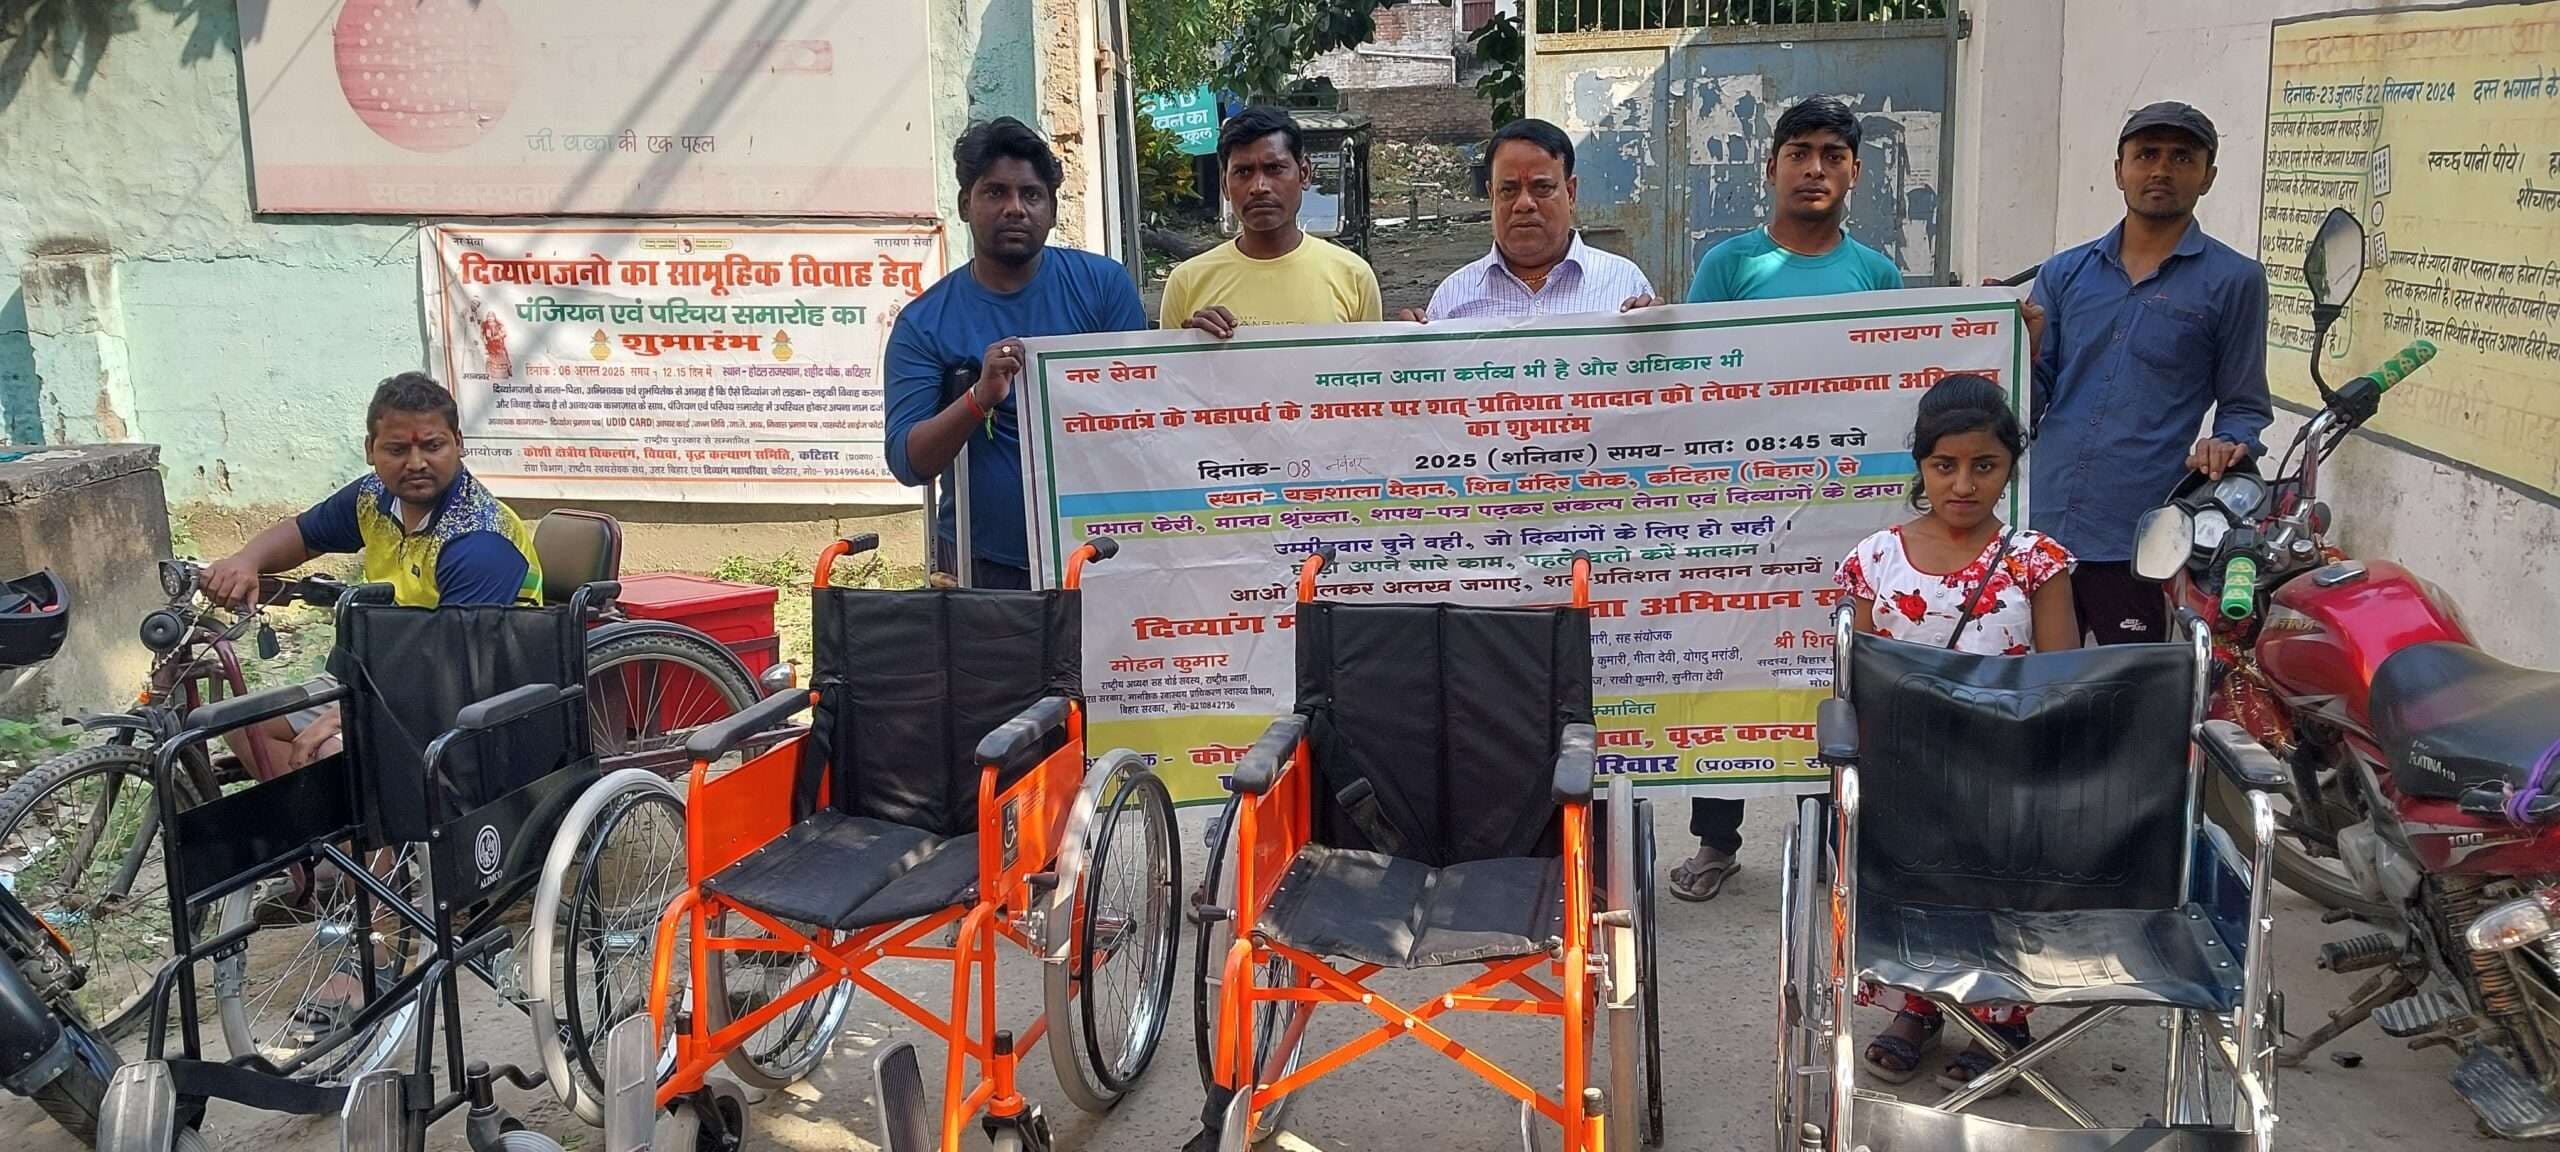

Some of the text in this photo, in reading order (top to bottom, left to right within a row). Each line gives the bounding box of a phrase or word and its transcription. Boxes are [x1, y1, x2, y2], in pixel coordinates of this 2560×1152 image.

[2383, 76, 2424, 104] सितम्बर
[2426, 82, 2456, 101] 2024
[2474, 64, 2560, 103] दस्त भगाने के
[1186, 110, 1209, 125] का
[618, 128, 637, 153] की
[647, 135, 672, 153] एक
[680, 135, 715, 154] पहल
[2428, 151, 2462, 175] स्वच्छ
[2463, 143, 2493, 173] पानी
[873, 235, 933, 248] नारायण सेवा
[459, 252, 924, 297] दिव्यांगजनो का सामूहिक विवाह हेतु
[2470, 256, 2544, 286] पतला होता
[2385, 278, 2405, 298] दस्त
[515, 296, 867, 326] पंजियन एवं परिचय समारोह का
[2454, 289, 2547, 321] दस्त पानी
[617, 330, 763, 356] शुभारंभ
[1848, 317, 1999, 343] नारायण सेवा
[2498, 329, 2547, 361] आशा दीदी
[559, 365, 570, 377] 06
[574, 365, 600, 377] अगस्त
[602, 365, 625, 377] 2025
[1065, 361, 1157, 383] नर सेवा
[1315, 371, 1383, 388] मतदान
[1390, 368, 1446, 384] अपना
[1523, 358, 1547, 378] भी
[1554, 358, 1570, 380] है
[1578, 357, 1618, 376] और
[1626, 353, 1712, 374] अधिकार
[1720, 349, 1744, 368] भी
[1062, 408, 1156, 433] लोकतंत्र
[1160, 407, 1187, 427] के
[1191, 402, 1272, 425] महापर्व
[1276, 400, 1303, 420] के
[1311, 401, 1384, 419] अवसर
[1389, 400, 1421, 416] पर
[1425, 391, 1564, 417] शत्-प्रतिशत
[1568, 390, 1654, 409] मतदान
[1658, 383, 1695, 404] को
[1699, 380, 1763, 401] लेकर
[606, 417, 628, 428] UDID
[1465, 412, 1592, 441] का शुभारंभ
[523, 446, 551, 459] कोशी
[709, 449, 751, 461] कल्याण
[799, 448, 840, 461] कटिहार
[1197, 458, 1281, 480] दिनांक-
[1415, 453, 1477, 469] 2025
[1487, 443, 1598, 472] (शनिवार)
[1607, 444, 1675, 461] समय-
[1745, 434, 1821, 452] 08:45
[1830, 427, 1868, 448] बजे
[1208, 457, 1859, 507] स्थान- यज्ञशाला मैदान, शिव मंदिर चौक, कटिहार (बिहार) से
[1086, 519, 1143, 536] प्रभात
[1151, 515, 1207, 534] फेरी,
[1215, 514, 1272, 529] मानव
[1371, 505, 1470, 521] शपथ-पत्र
[1478, 502, 1545, 520] पढ़कर
[1552, 496, 1624, 513] संकल्प
[1632, 492, 1680, 509] लेना
[1687, 489, 1718, 508] एवं
[1727, 484, 1813, 505] दिव्यांगों
[1822, 482, 1846, 498] के
[1853, 483, 1905, 499] द्वारा
[1273, 515, 1775, 556] उम्मीवार चुने वही, जो दिव्यांगों के लिए हो सही
[1349, 556, 1401, 574] अपने
[1408, 554, 1449, 572] सारे
[1457, 555, 1516, 570] काम,
[1640, 543, 1676, 561] करें
[1686, 543, 1759, 559] मतदान
[1230, 556, 1823, 602] आओ अलख जगाए, मतदान करायें
[1131, 590, 1804, 640] दिव्यांग अभियान
[1616, 629, 1673, 645] सह संयोजक
[1774, 630, 1795, 649] श्री
[1109, 654, 1229, 673] मोहन कुमार
[1633, 651, 1656, 665] गीता
[1658, 650, 1680, 666] देवी,
[1757, 654, 1826, 667] सदस्य, बिहार
[1610, 669, 1723, 687] राखी कुमारी, सुनीता देवी
[1771, 667, 1803, 677] समाज
[1665, 725, 1728, 749] वृद्ध
[480, 869, 503, 890] ALIMCO
